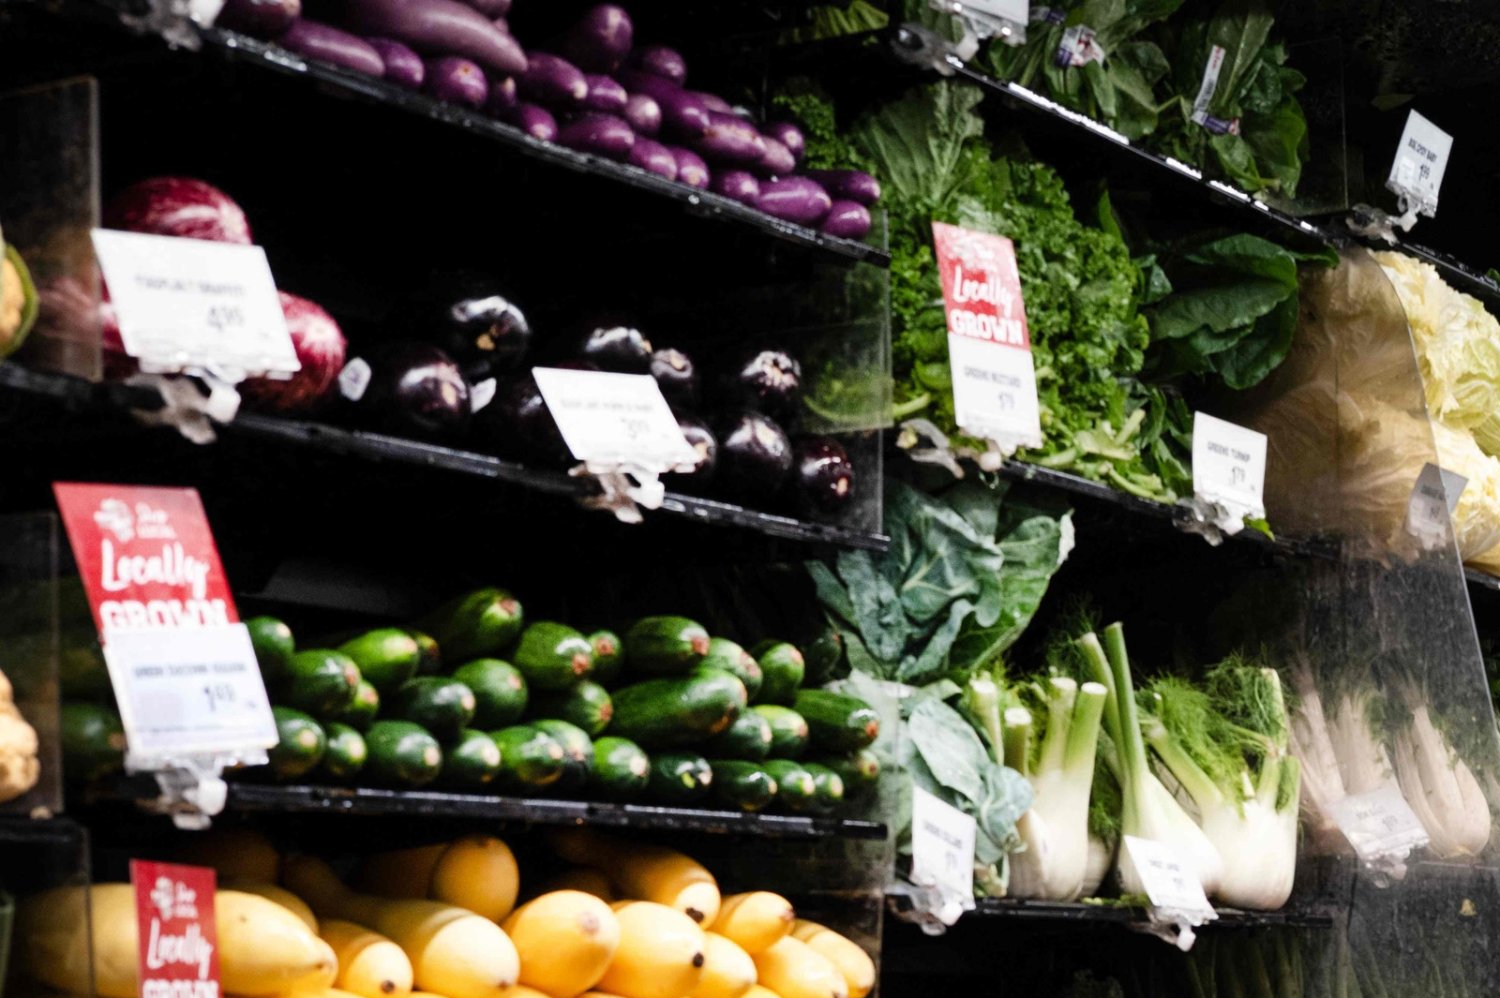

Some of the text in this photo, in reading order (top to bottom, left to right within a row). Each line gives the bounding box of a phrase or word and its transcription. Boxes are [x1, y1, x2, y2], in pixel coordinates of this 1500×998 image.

[953, 265, 1015, 318] Locally
[951, 308, 1024, 345] GROWN
[101, 538, 210, 600] Locally
[147, 917, 213, 980] Locally
